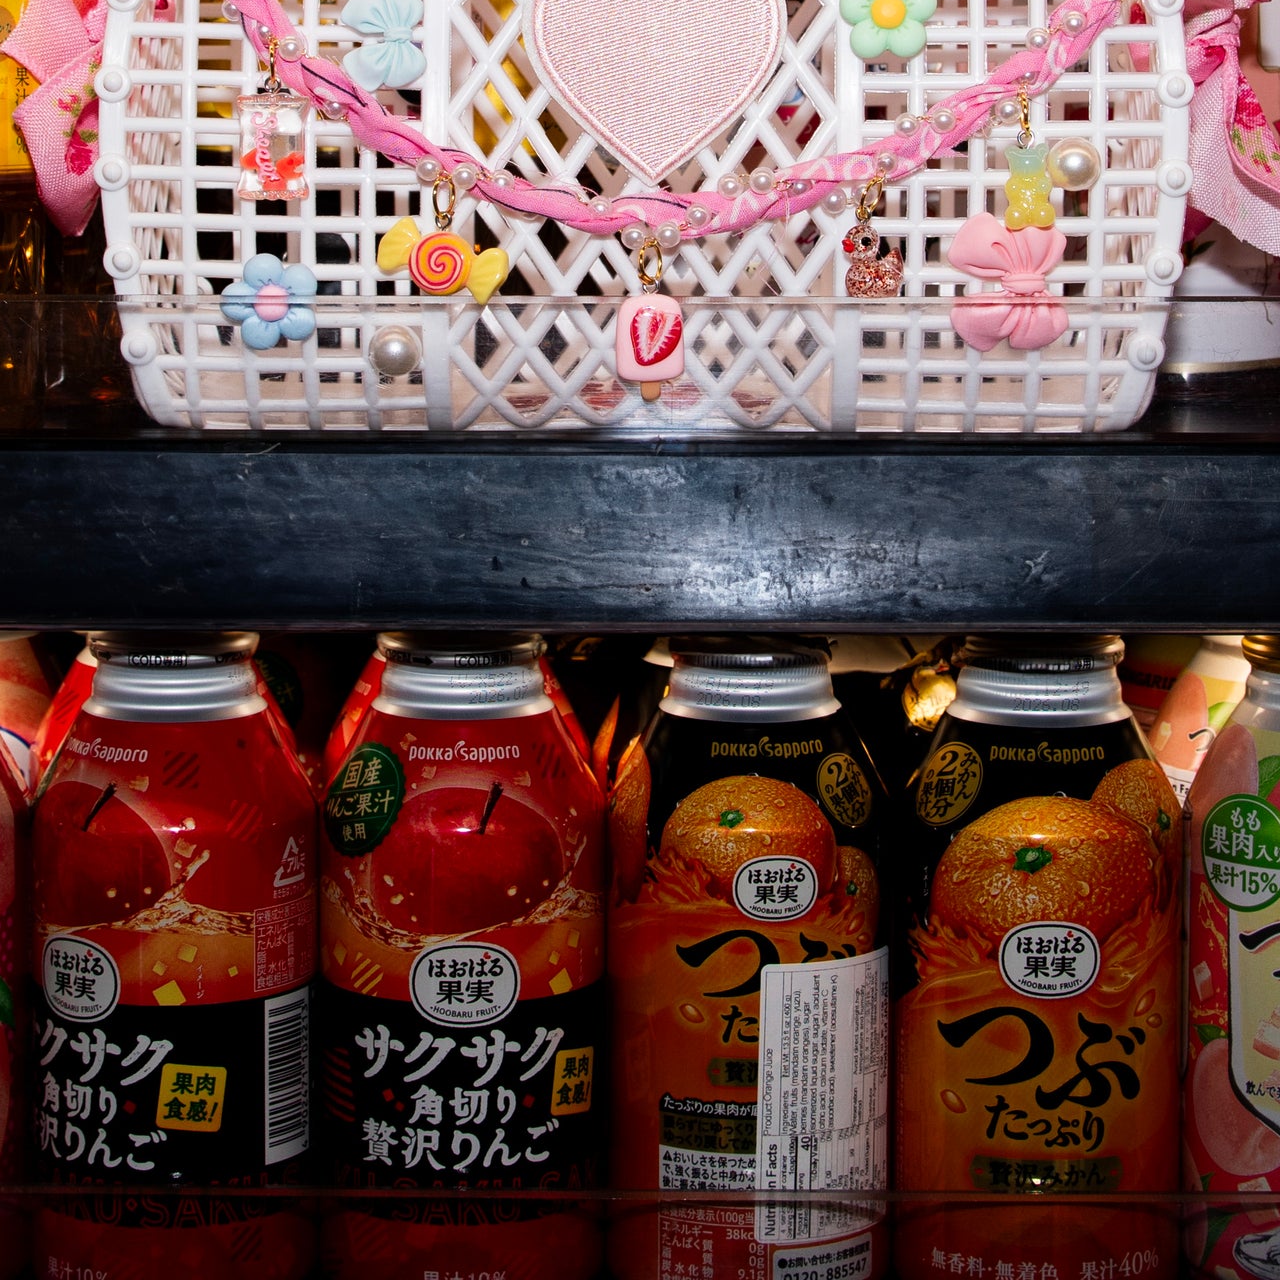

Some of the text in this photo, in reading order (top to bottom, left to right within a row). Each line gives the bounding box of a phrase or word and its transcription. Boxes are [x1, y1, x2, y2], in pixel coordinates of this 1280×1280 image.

[754, 883, 799, 905] 果実
[1209, 867, 1278, 897] 果汁15%
[1017, 935, 1085, 957] ほおばる
[428, 955, 504, 980] ほおばる
[1024, 954, 1077, 980] 果実
[437, 977, 495, 1005] 果実
[355, 1025, 565, 1087] サクサク
[937, 1004, 1146, 1113] つぶ
[409, 1084, 517, 1125] 角切り
[985, 1096, 1105, 1152] たっぷり
[361, 1118, 559, 1172] 贅沢りんご
